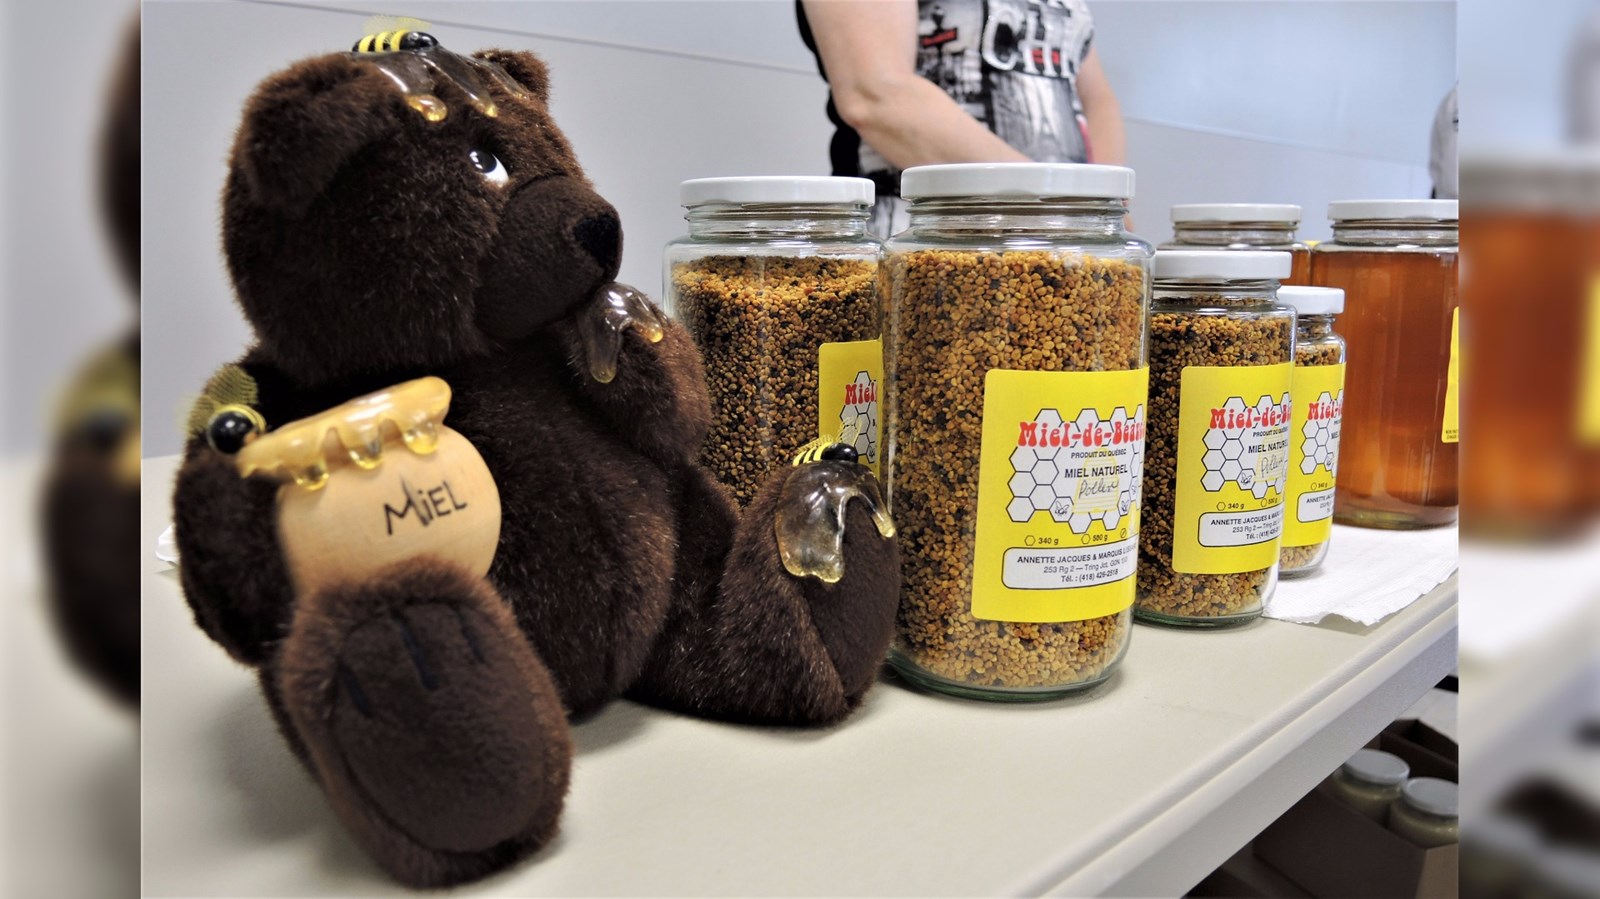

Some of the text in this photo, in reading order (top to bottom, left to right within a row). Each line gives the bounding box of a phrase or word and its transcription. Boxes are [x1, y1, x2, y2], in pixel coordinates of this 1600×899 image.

[845, 382, 877, 405] Miel
[1248, 444, 1267, 453] MIEL
[1071, 451, 1098, 459] PRODUIT
[1064, 464, 1128, 478] MIEL NATUREL
[1243, 515, 1267, 524] JACQUES
[1038, 537, 1052, 545] 340
[1017, 556, 1055, 564] ANNETTE
[1056, 554, 1091, 563] JACQUES
[1092, 553, 1097, 561] &
[1098, 548, 1122, 559] MARQUIS
[1059, 565, 1069, 574] Rg
[1070, 565, 1075, 573] 2
[1079, 573, 1095, 582] (418)
